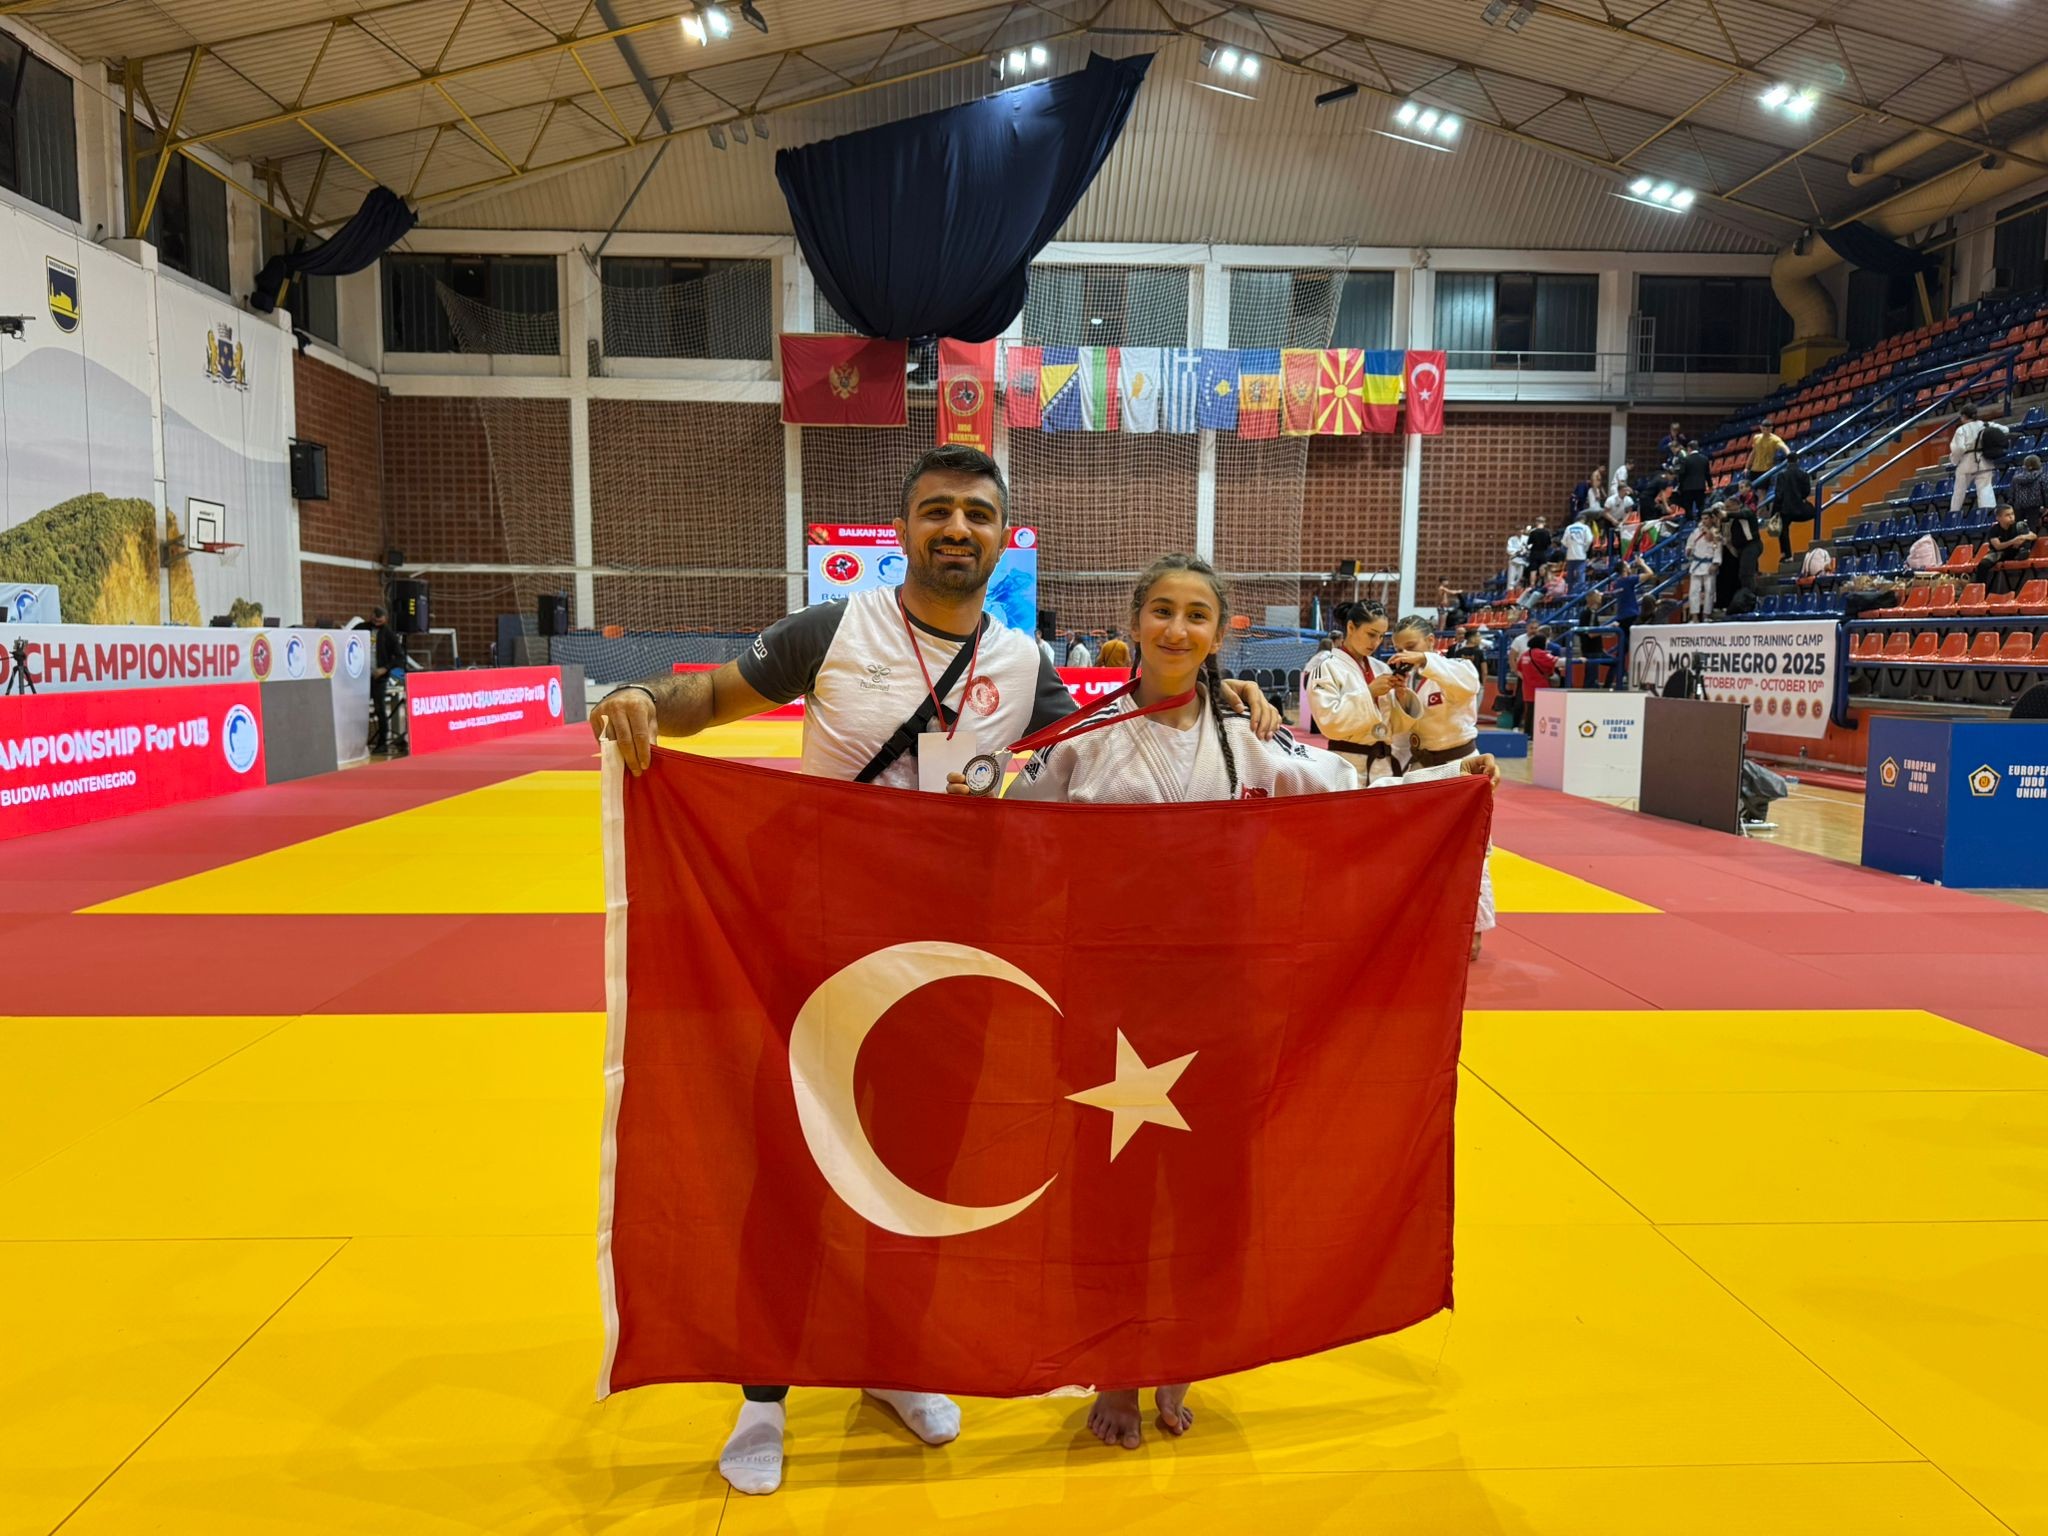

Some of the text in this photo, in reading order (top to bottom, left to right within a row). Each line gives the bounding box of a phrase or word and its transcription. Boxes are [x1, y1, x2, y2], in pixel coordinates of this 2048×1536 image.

[838, 528, 896, 538] BALKAN JUD
[1669, 633, 1824, 648] INTERNATIONAL JUDO TRAINING CAMP
[24, 643, 240, 684] CHAMPIONSHIP
[1668, 652, 1826, 675] MOTENEGRO 2025
[1703, 676, 1735, 689] CTOBER
[1760, 678, 1806, 692] OCTOBER
[413, 696, 449, 716] BALKAN
[450, 693, 472, 711] JUDO
[144, 724, 176, 752] For
[1904, 759, 1936, 773] EUROPEAN
[1910, 770, 1927, 783] JUDO
[2019, 776, 2045, 788] JUDO
[0, 770, 136, 806] BUDVA MONTENEGRO
[1908, 782, 1928, 793] UNION
[2016, 787, 2047, 799] UNION
